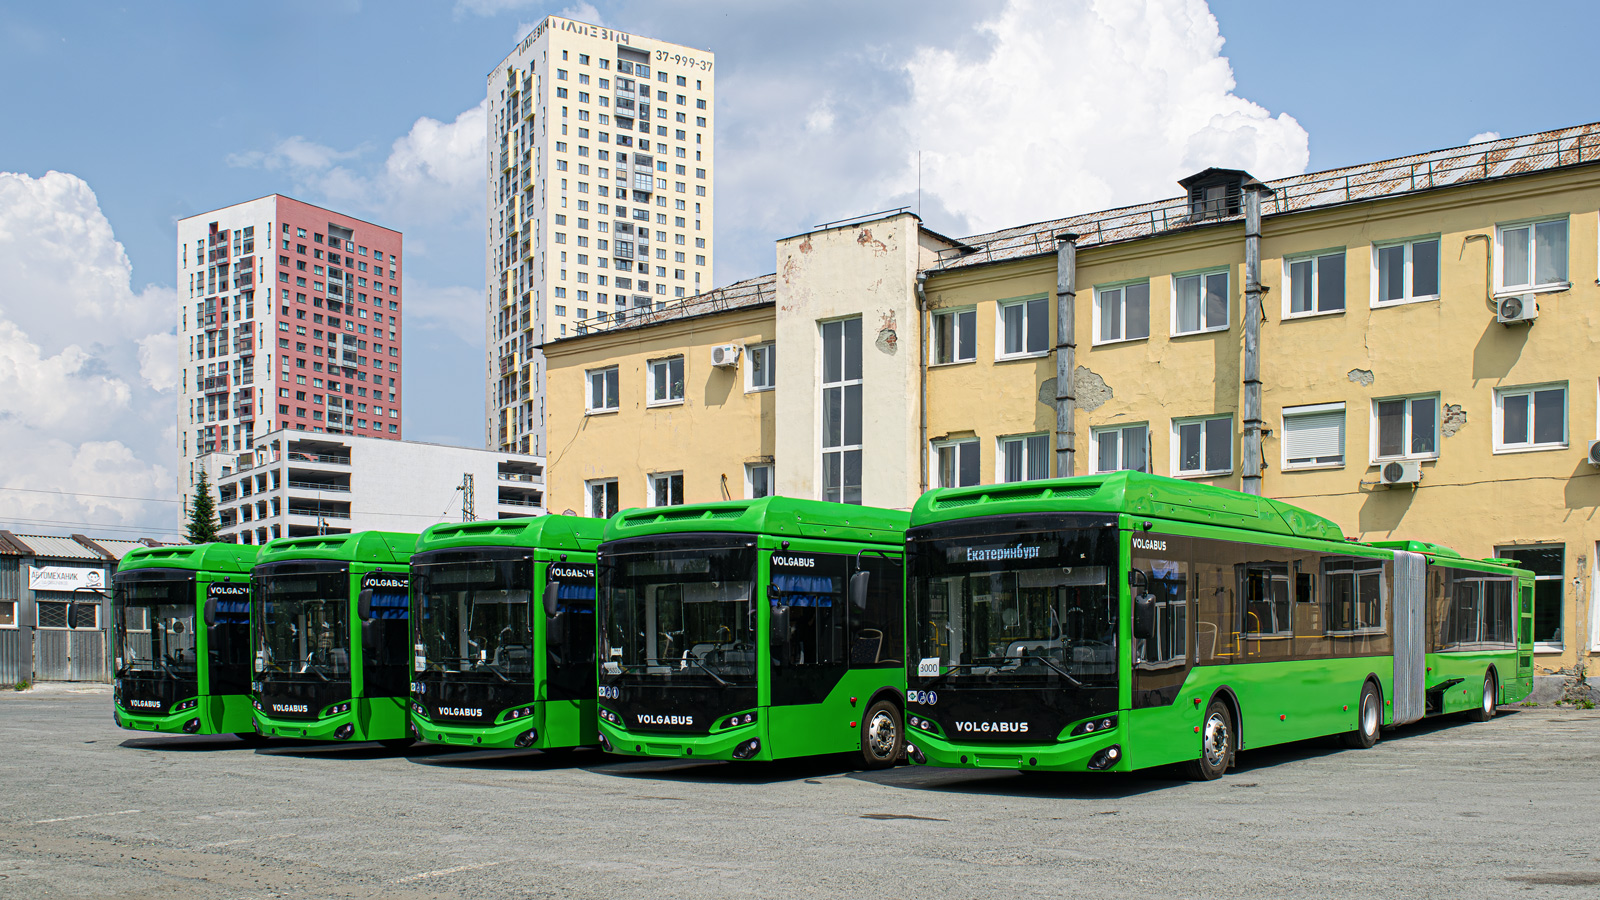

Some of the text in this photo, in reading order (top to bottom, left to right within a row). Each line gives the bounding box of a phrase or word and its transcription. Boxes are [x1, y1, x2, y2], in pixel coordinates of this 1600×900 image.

[655, 50, 713, 73] 37-999-37
[1132, 538, 1167, 551] VOLGABUS
[967, 543, 1040, 561] Екатеринбург
[772, 556, 815, 568] VOLGABUS
[129, 699, 161, 708] VOLGABUS
[272, 704, 308, 713] VOLGABUS
[438, 706, 483, 717] VOLGABUS
[637, 714, 693, 726] VOLGABUS
[955, 722, 1029, 734] VOLGABUS
